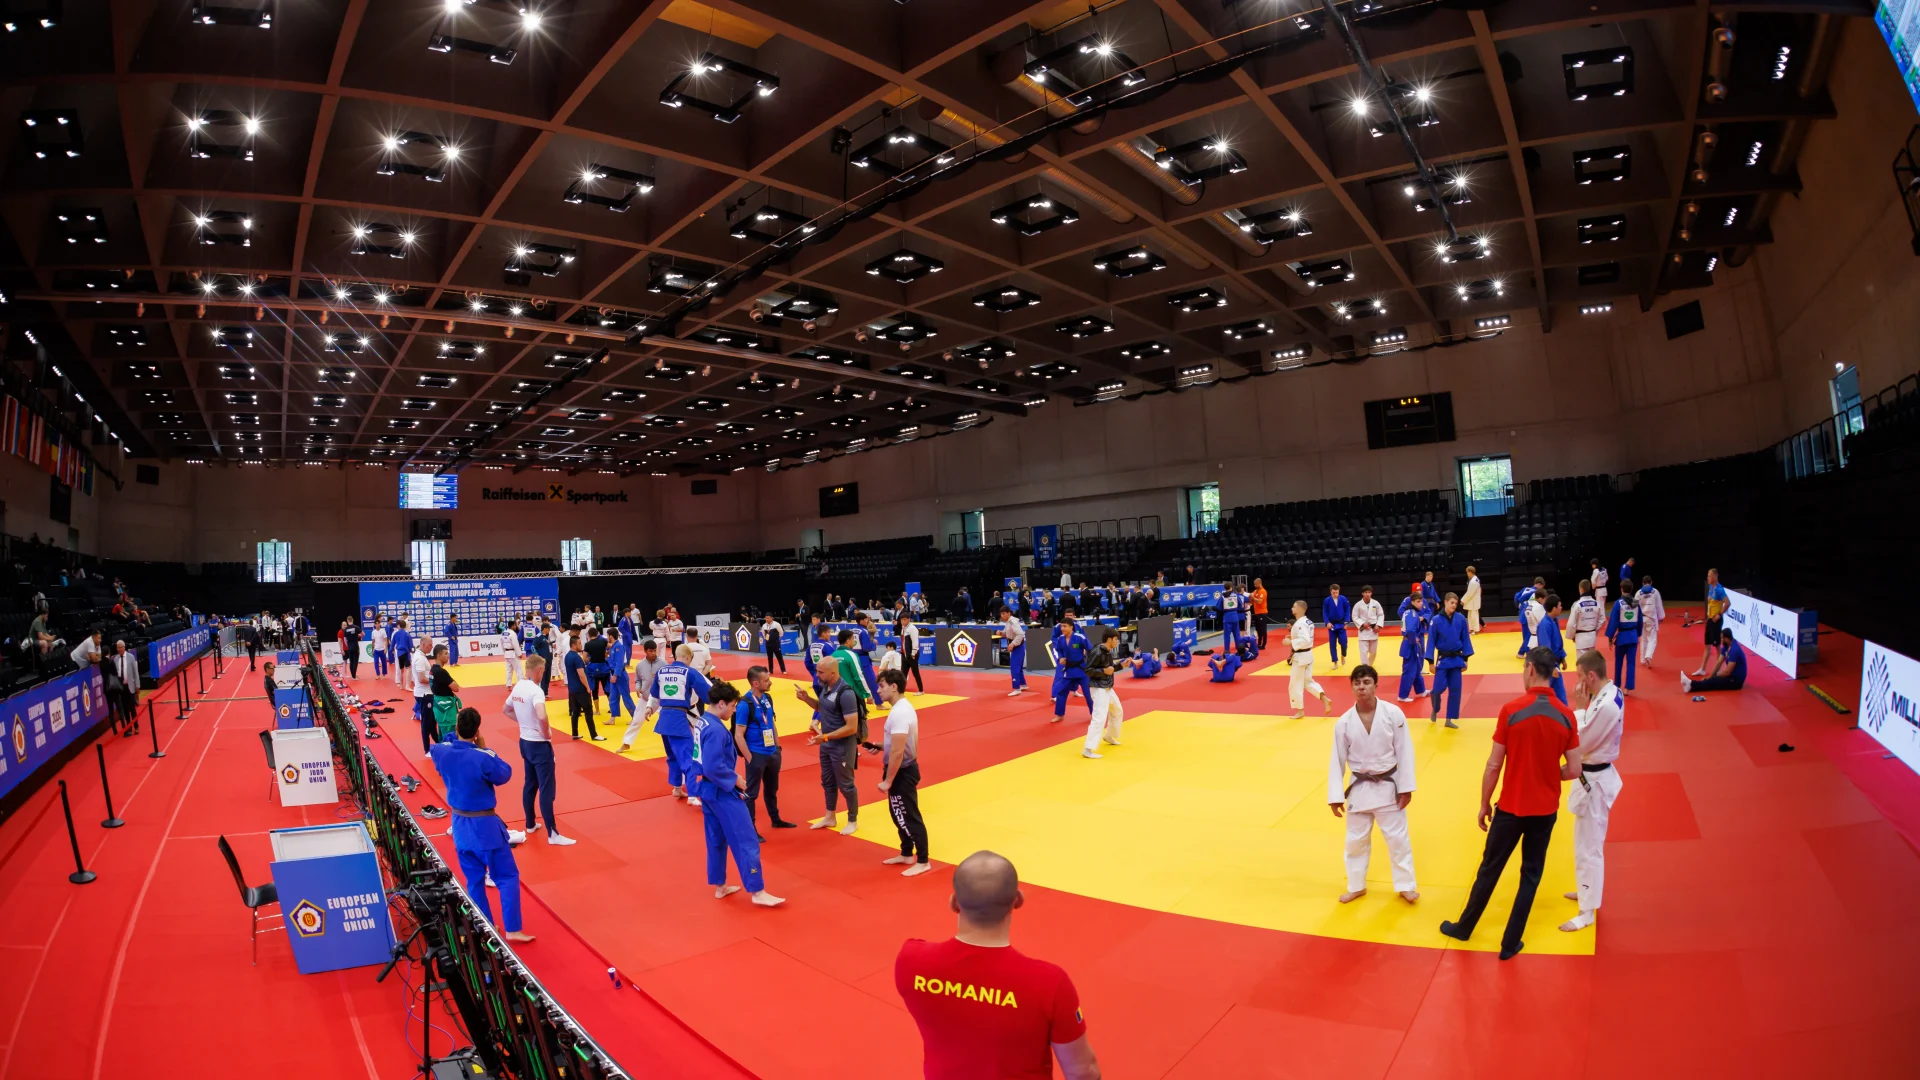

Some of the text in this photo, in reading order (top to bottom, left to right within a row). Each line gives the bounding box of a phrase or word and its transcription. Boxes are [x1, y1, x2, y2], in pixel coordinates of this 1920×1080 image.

[482, 487, 628, 504] Raiffeisen Sportpark
[412, 590, 428, 598] GRAZ
[428, 590, 448, 598] JUNIOR
[449, 589, 478, 597] EUROPEAN
[491, 588, 507, 596] 2026
[1761, 622, 1794, 651] MILLENNIUM
[480, 642, 499, 650] triglav
[1891, 690, 1920, 729] MILL
[301, 761, 330, 769] EUROPEAN
[309, 775, 327, 783] UNION
[327, 892, 380, 910] EUROPEAN
[344, 906, 369, 920] JUDO
[343, 918, 376, 933] UNION
[914, 975, 1018, 1009] ROMANIA
